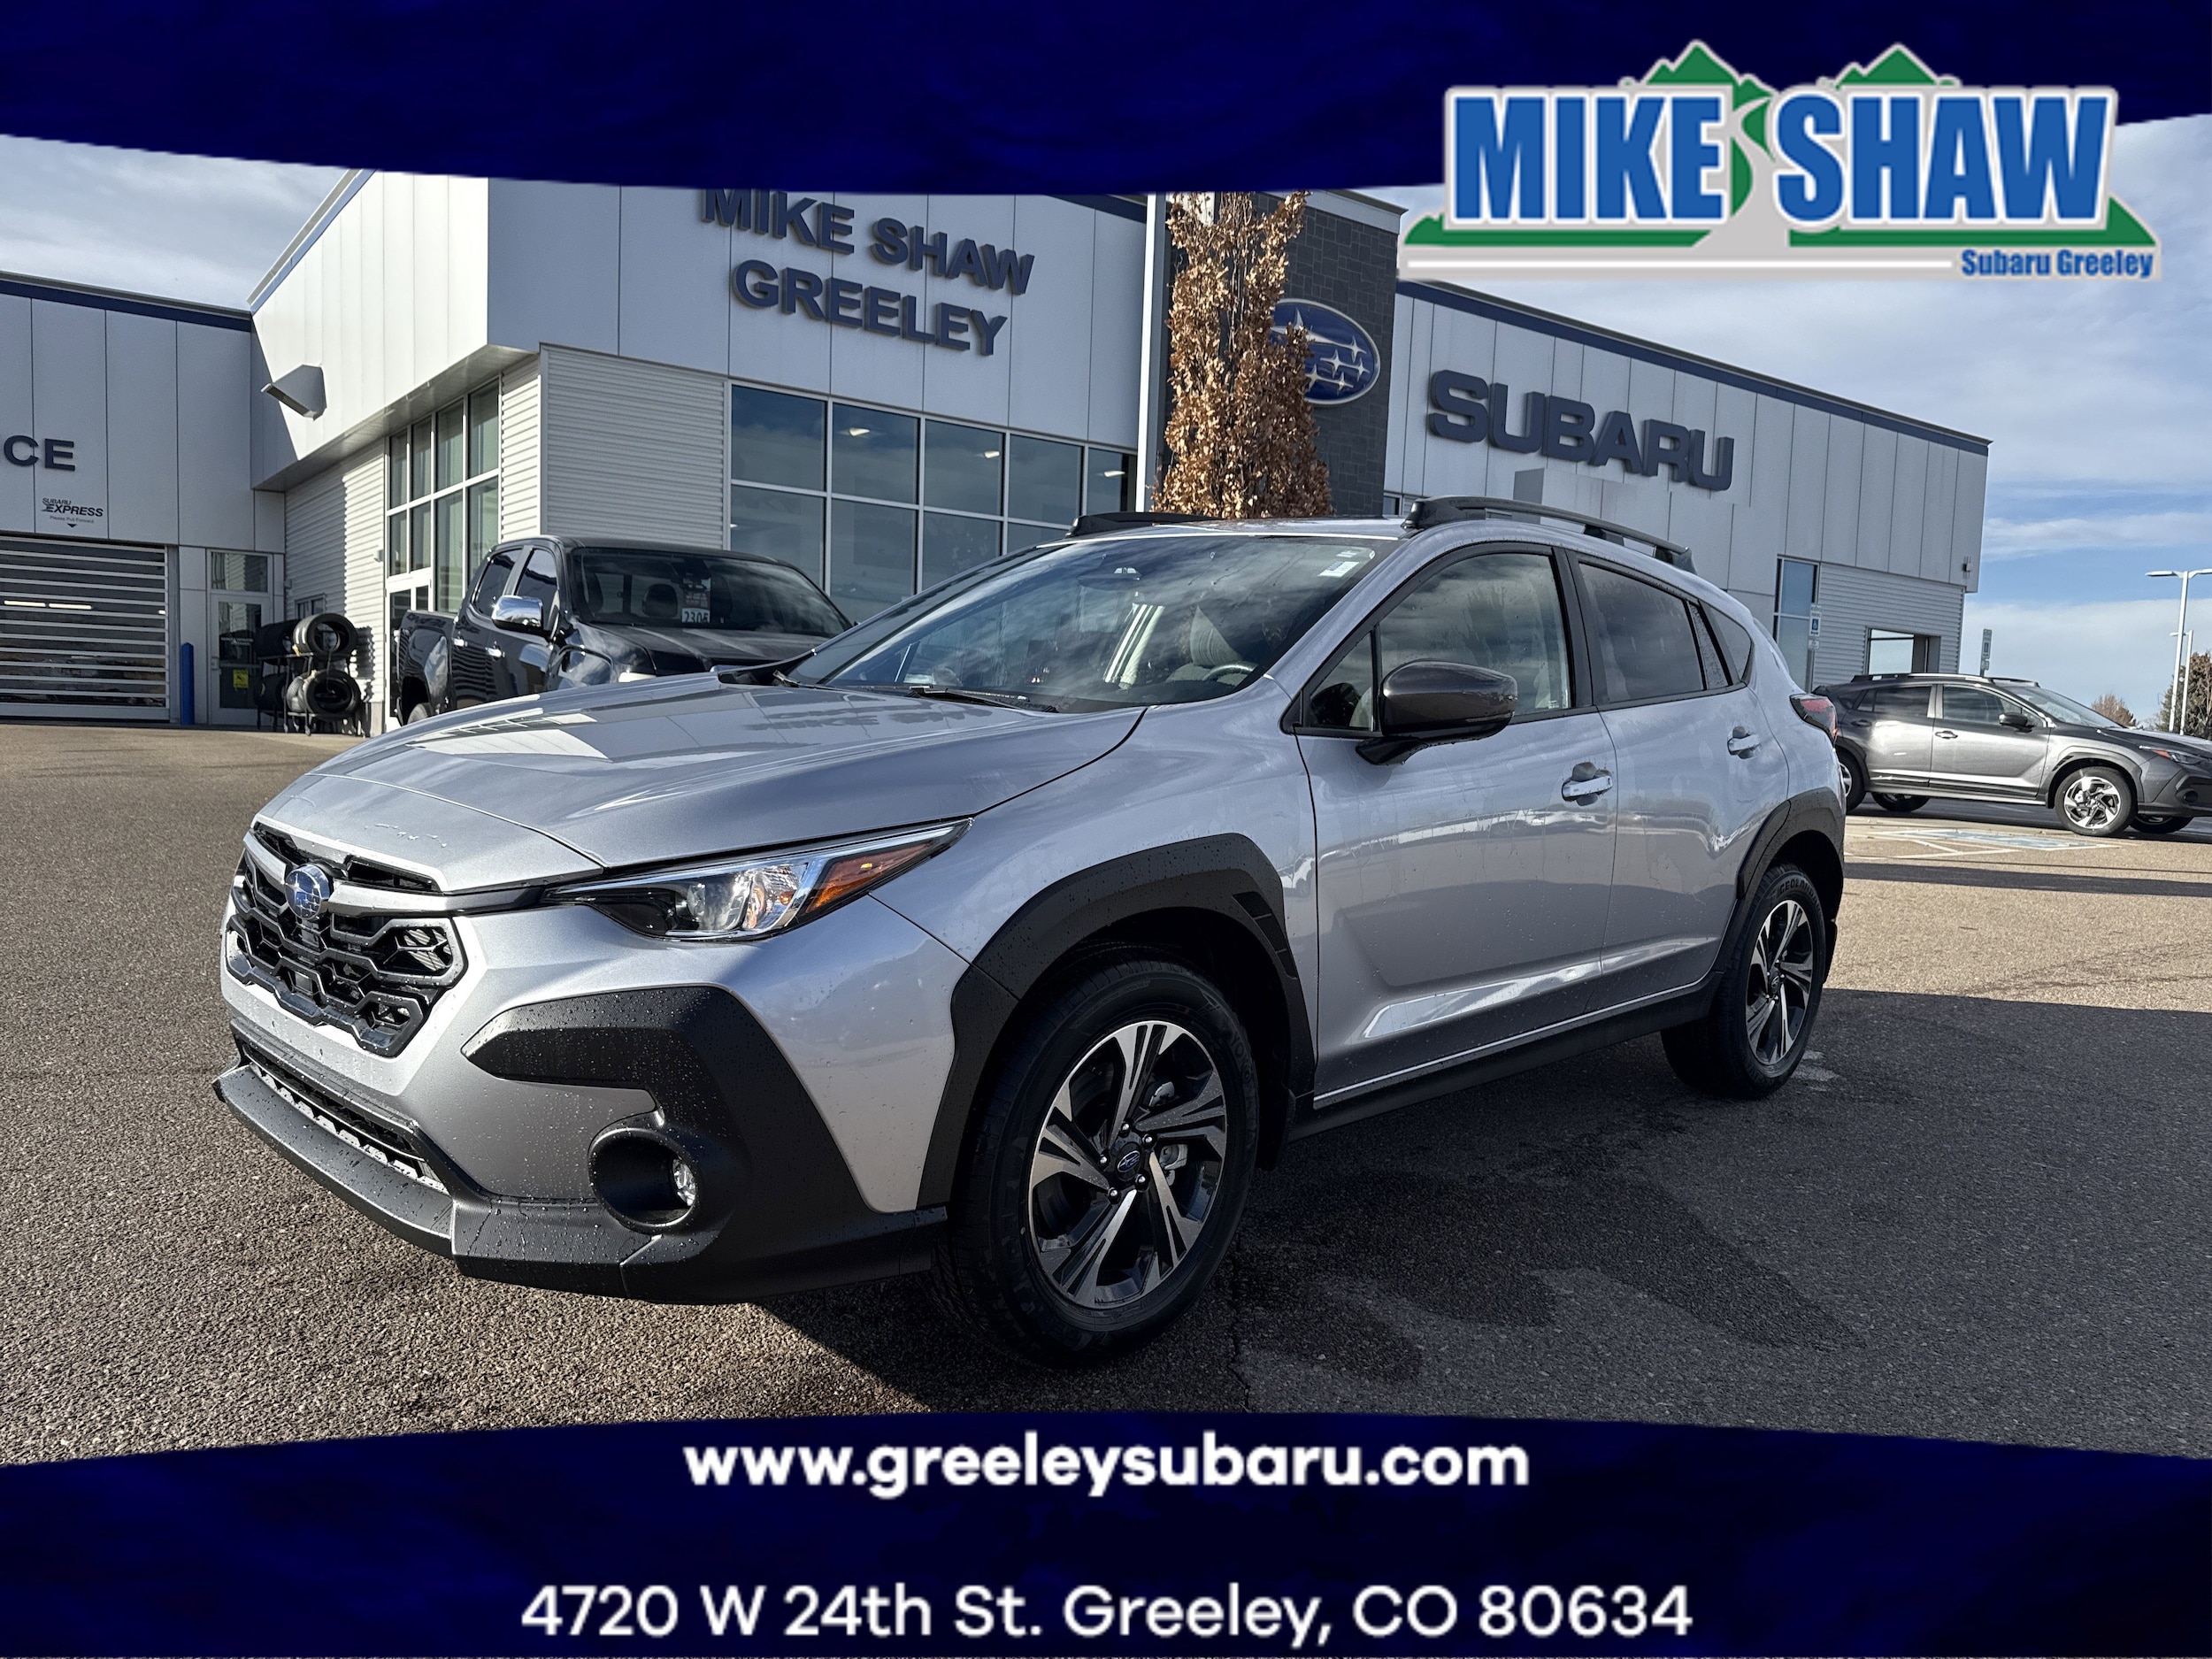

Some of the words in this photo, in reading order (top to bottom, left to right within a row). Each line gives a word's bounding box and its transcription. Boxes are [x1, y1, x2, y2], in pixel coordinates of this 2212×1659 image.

[702, 188, 855, 255] MIKE
[869, 217, 1035, 295] SHAW
[733, 259, 1008, 356] GREELEY
[4, 434, 76, 472] CE
[1428, 369, 1735, 491] SUBARU
[41, 503, 104, 518] EXPRESS
